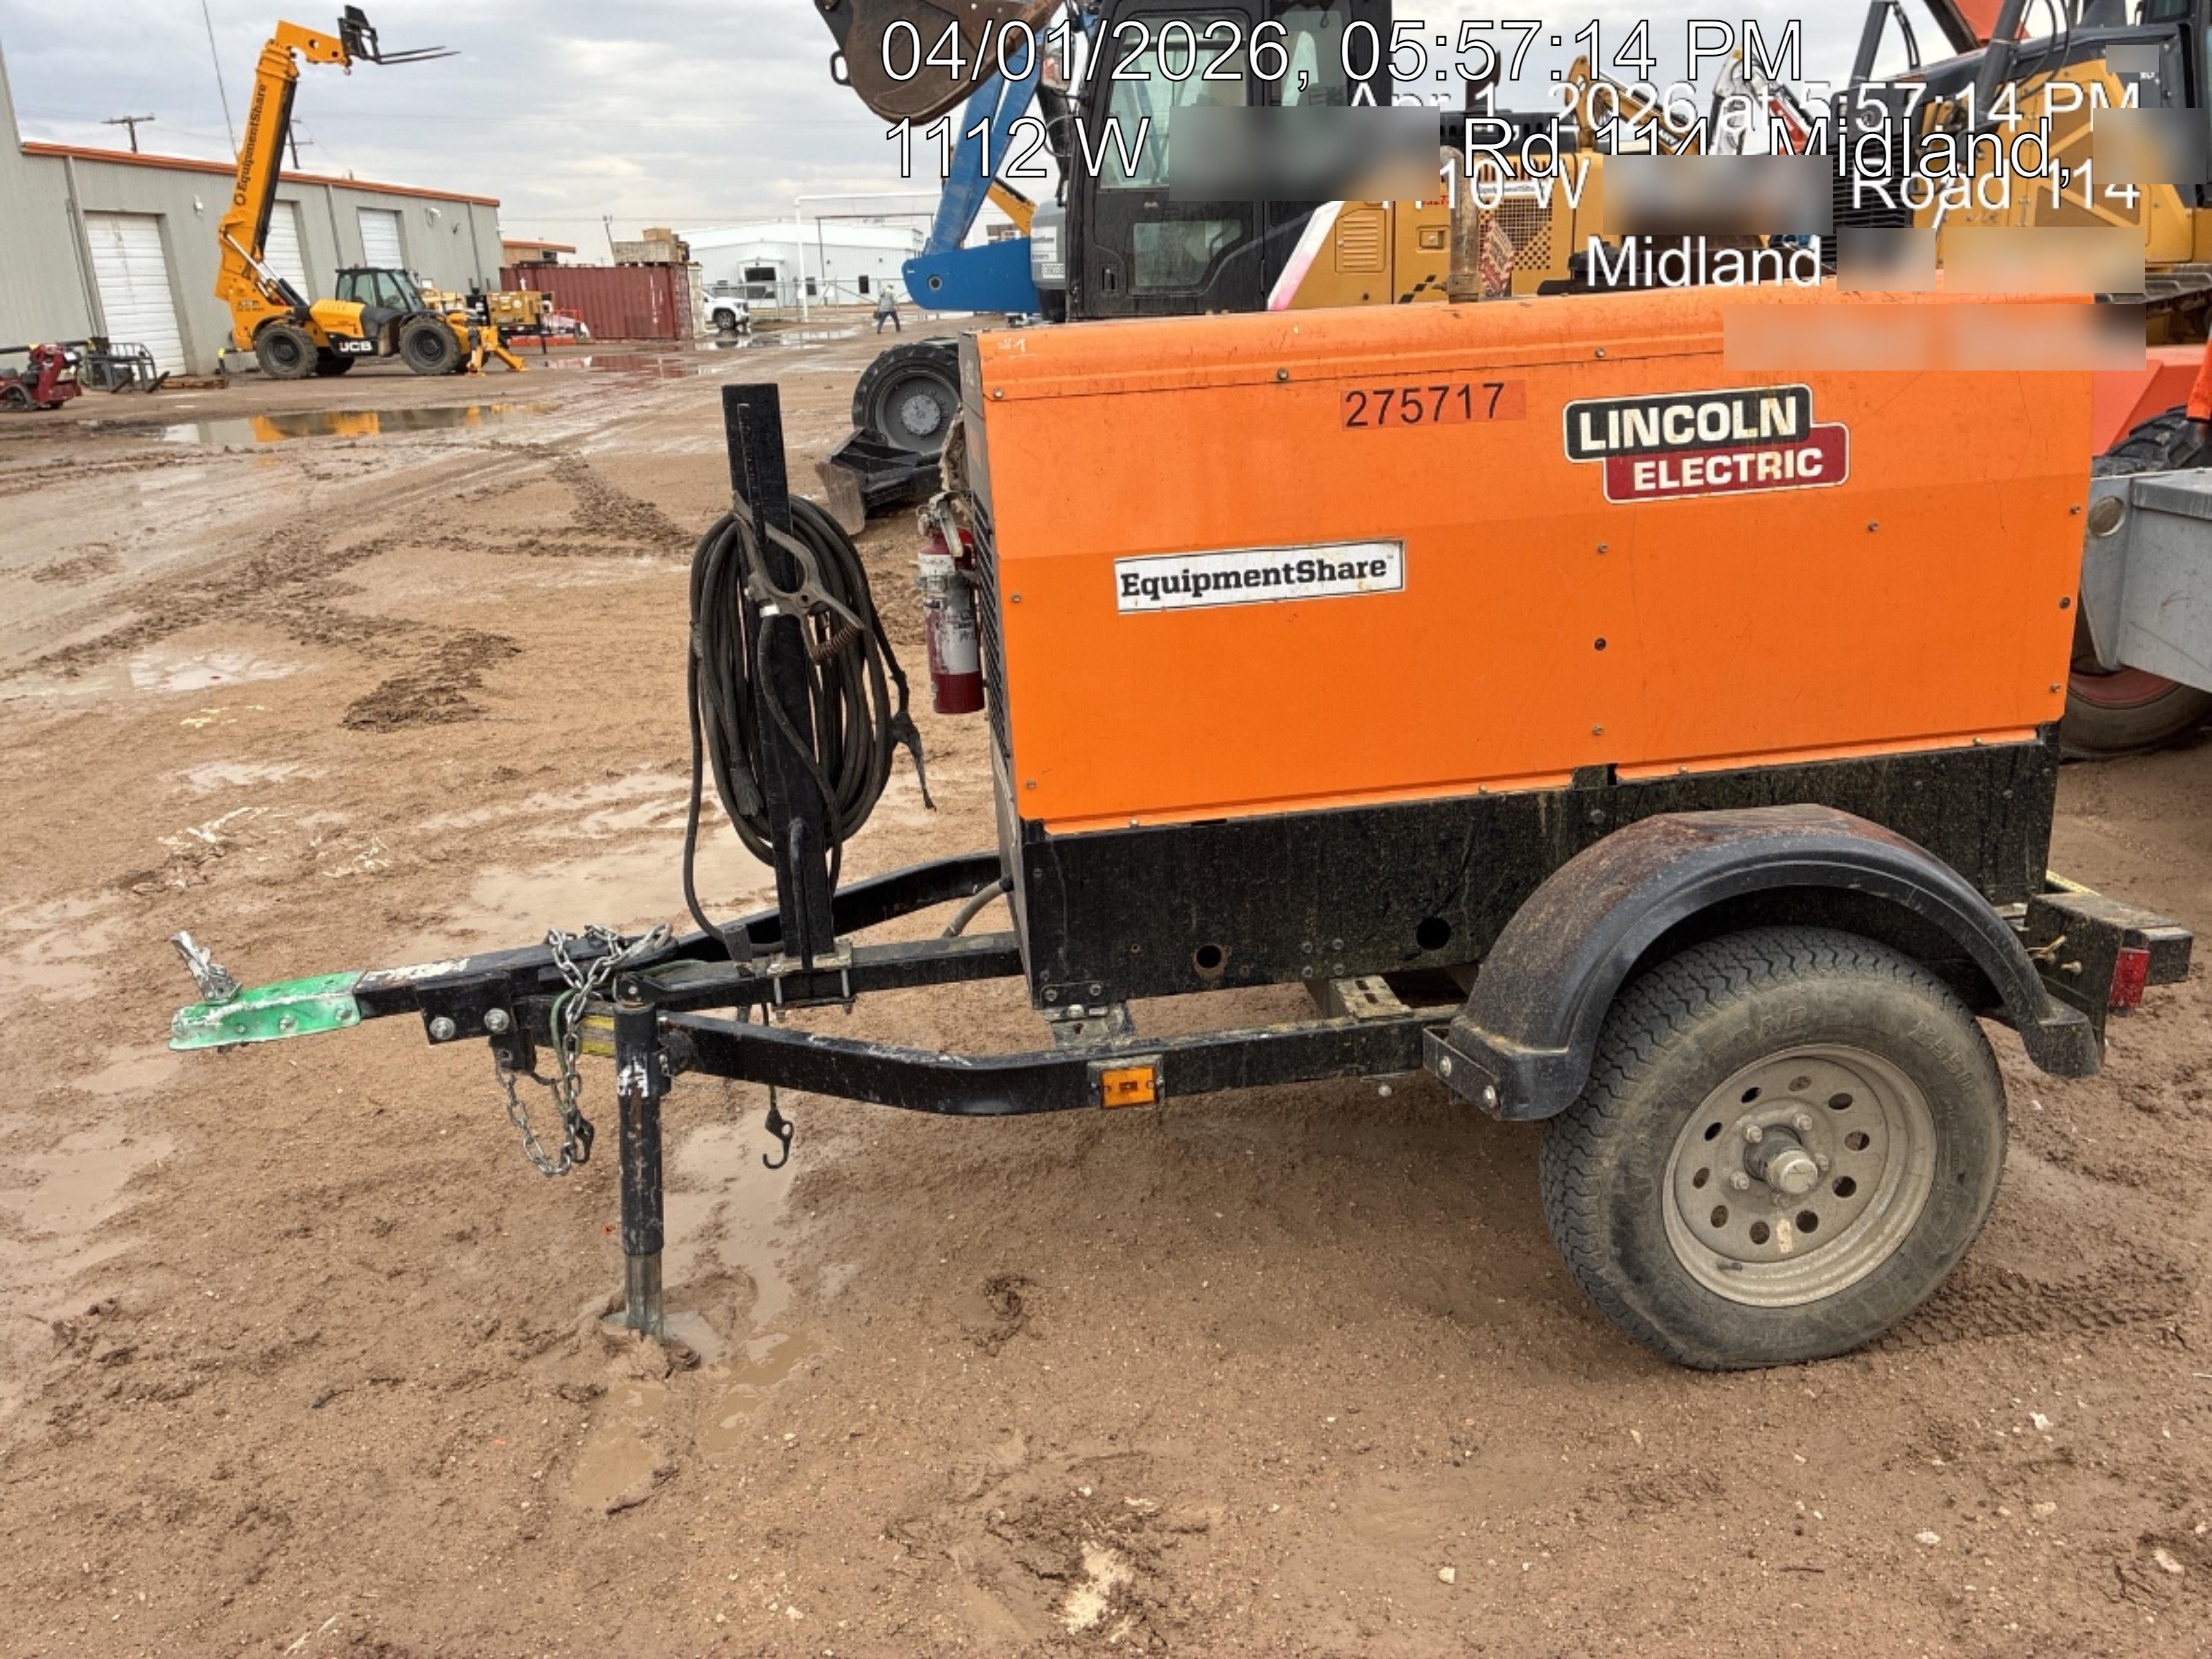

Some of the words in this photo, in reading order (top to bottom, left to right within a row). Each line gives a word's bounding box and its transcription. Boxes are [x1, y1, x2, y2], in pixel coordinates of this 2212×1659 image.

[339, 340, 373, 352] JCB
[1345, 381, 1505, 428] 275717
[1578, 394, 1798, 452] LINCOLN
[1633, 446, 1824, 492] ELECTRIC
[1120, 558, 1387, 602] EquipmentShare
